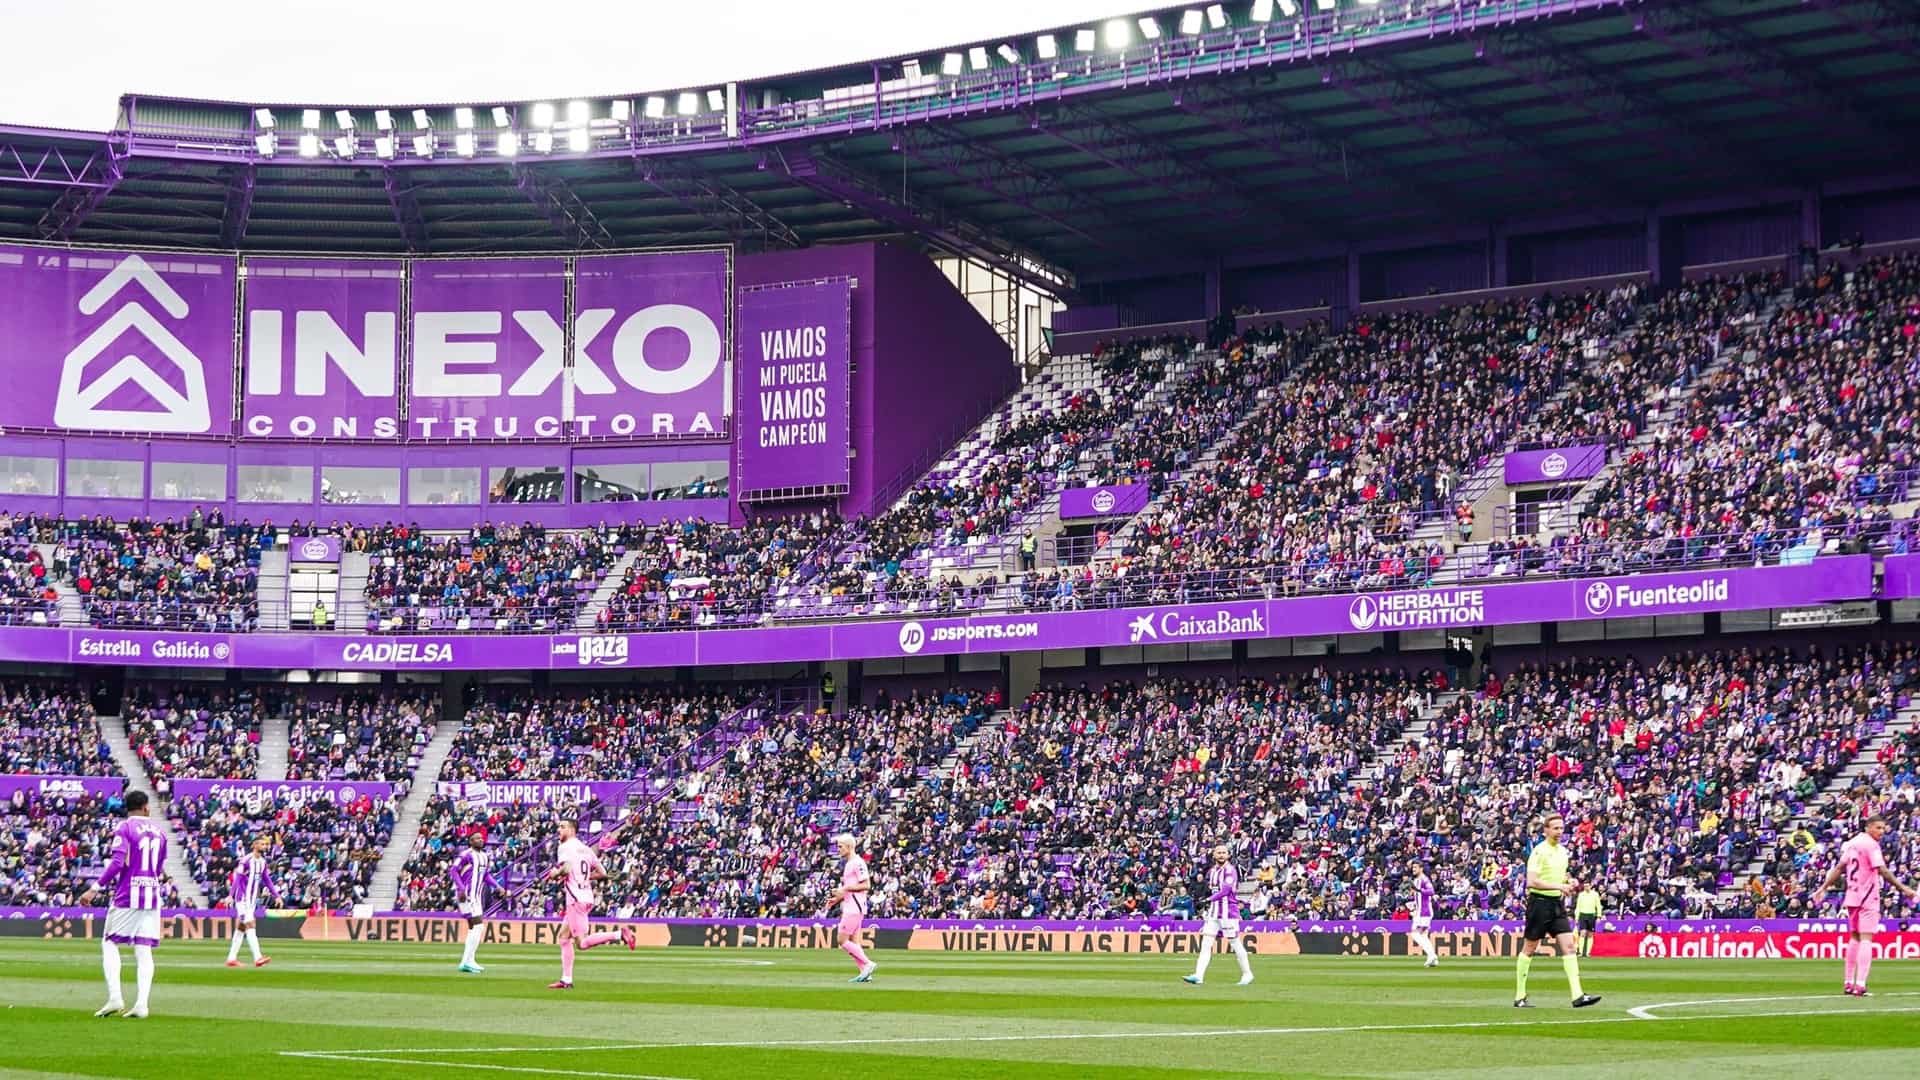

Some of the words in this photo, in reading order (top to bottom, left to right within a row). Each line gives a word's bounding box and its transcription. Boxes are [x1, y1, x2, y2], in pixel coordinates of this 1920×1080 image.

[248, 304, 721, 397] INEXO
[761, 325, 826, 361] VAMOS
[760, 366, 776, 387] MI
[780, 361, 827, 385] PUCELA
[760, 386, 826, 422] VAMOS
[248, 411, 714, 438] CONSTRUCTORA
[760, 420, 826, 447] CAMPEÓN
[1379, 590, 1483, 611] HERBALIFE
[1615, 578, 1728, 608] Fuenteolid
[1161, 608, 1264, 636] CaixaBank
[1379, 606, 1484, 627] NUTRITION
[903, 630, 921, 645] JD
[930, 623, 1039, 641] JDSPORTS.COM
[79, 638, 141, 657] Estrella
[152, 640, 210, 659] Galicia
[343, 643, 453, 662] CADIELSA
[578, 637, 628, 664] gaza
[485, 785, 539, 803] SIEMPRE
[544, 785, 591, 803] PUCELA
[139, 836, 161, 872] 11
[580, 860, 588, 880] 9
[346, 919, 459, 942] VUELVEN
[737, 925, 875, 949] LEGENS
[1670, 934, 1754, 958] LaLiga
[1785, 935, 1920, 959] Santnde
